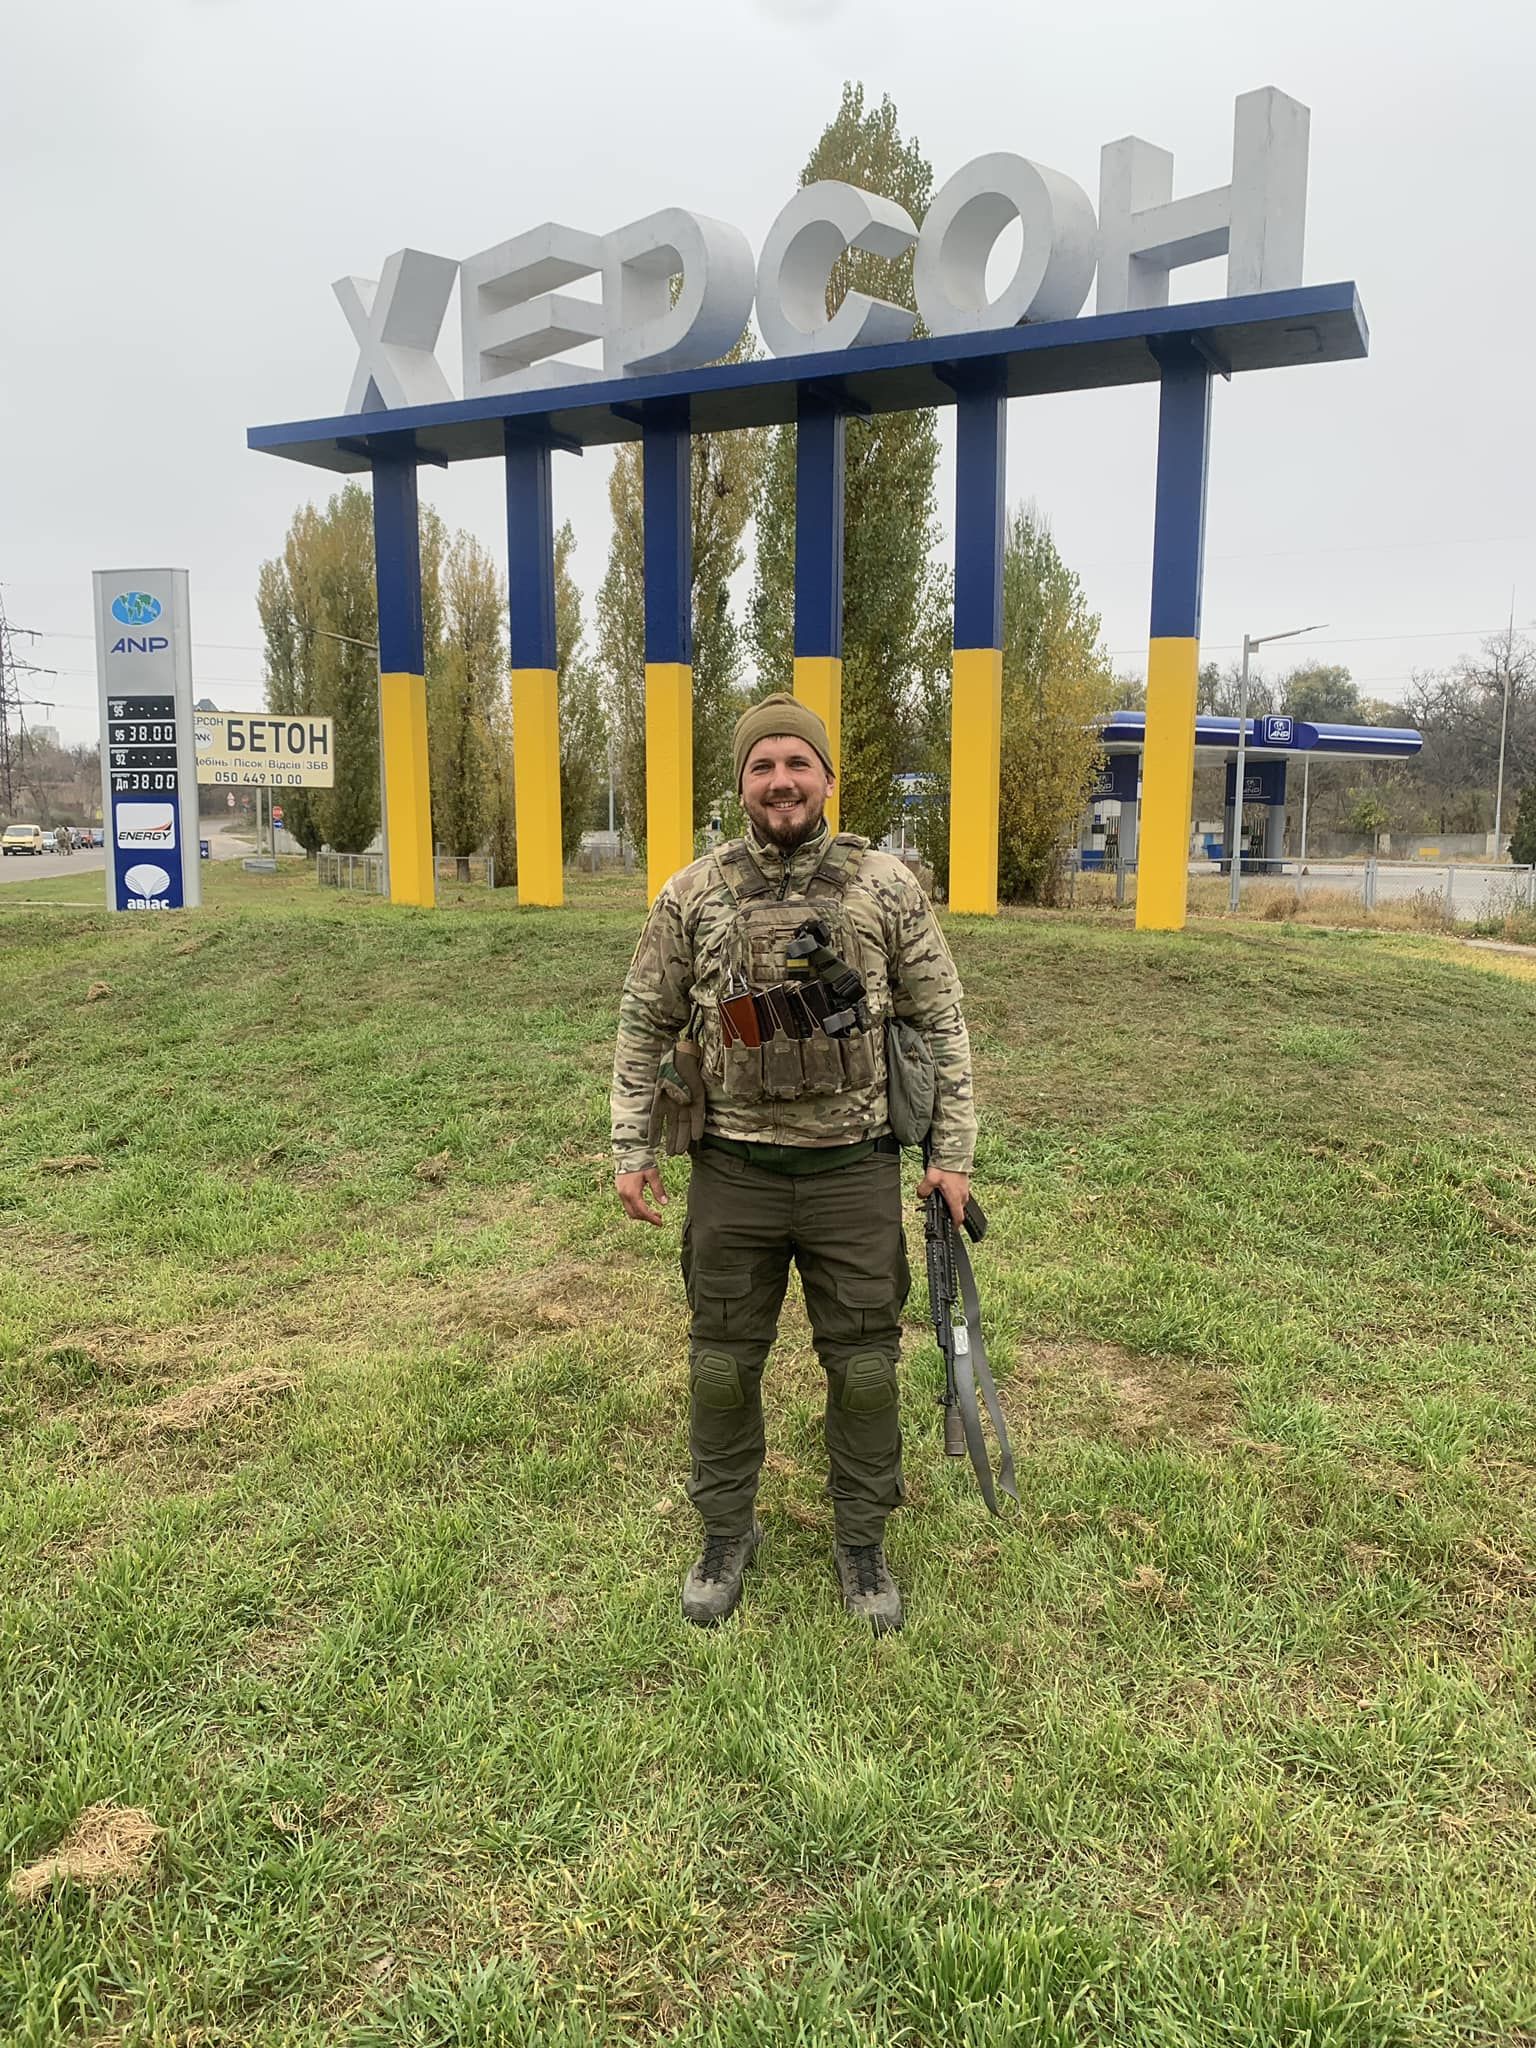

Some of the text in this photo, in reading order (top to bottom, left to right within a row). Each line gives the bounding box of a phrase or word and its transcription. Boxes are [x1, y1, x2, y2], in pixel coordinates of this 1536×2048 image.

[331, 86, 1310, 415] ХЕРСОН
[110, 637, 169, 653] ANP
[113, 705, 124, 717] 95
[114, 725, 173, 741] 95 38.00
[227, 719, 328, 755] БЕТОН
[115, 754, 126, 765] 92
[234, 758, 262, 769] Пісок
[268, 759, 301, 770] Відсів
[132, 774, 175, 790] 38.00
[215, 771, 302, 785] 050 449 10 00
[118, 831, 171, 841] ENERGY
